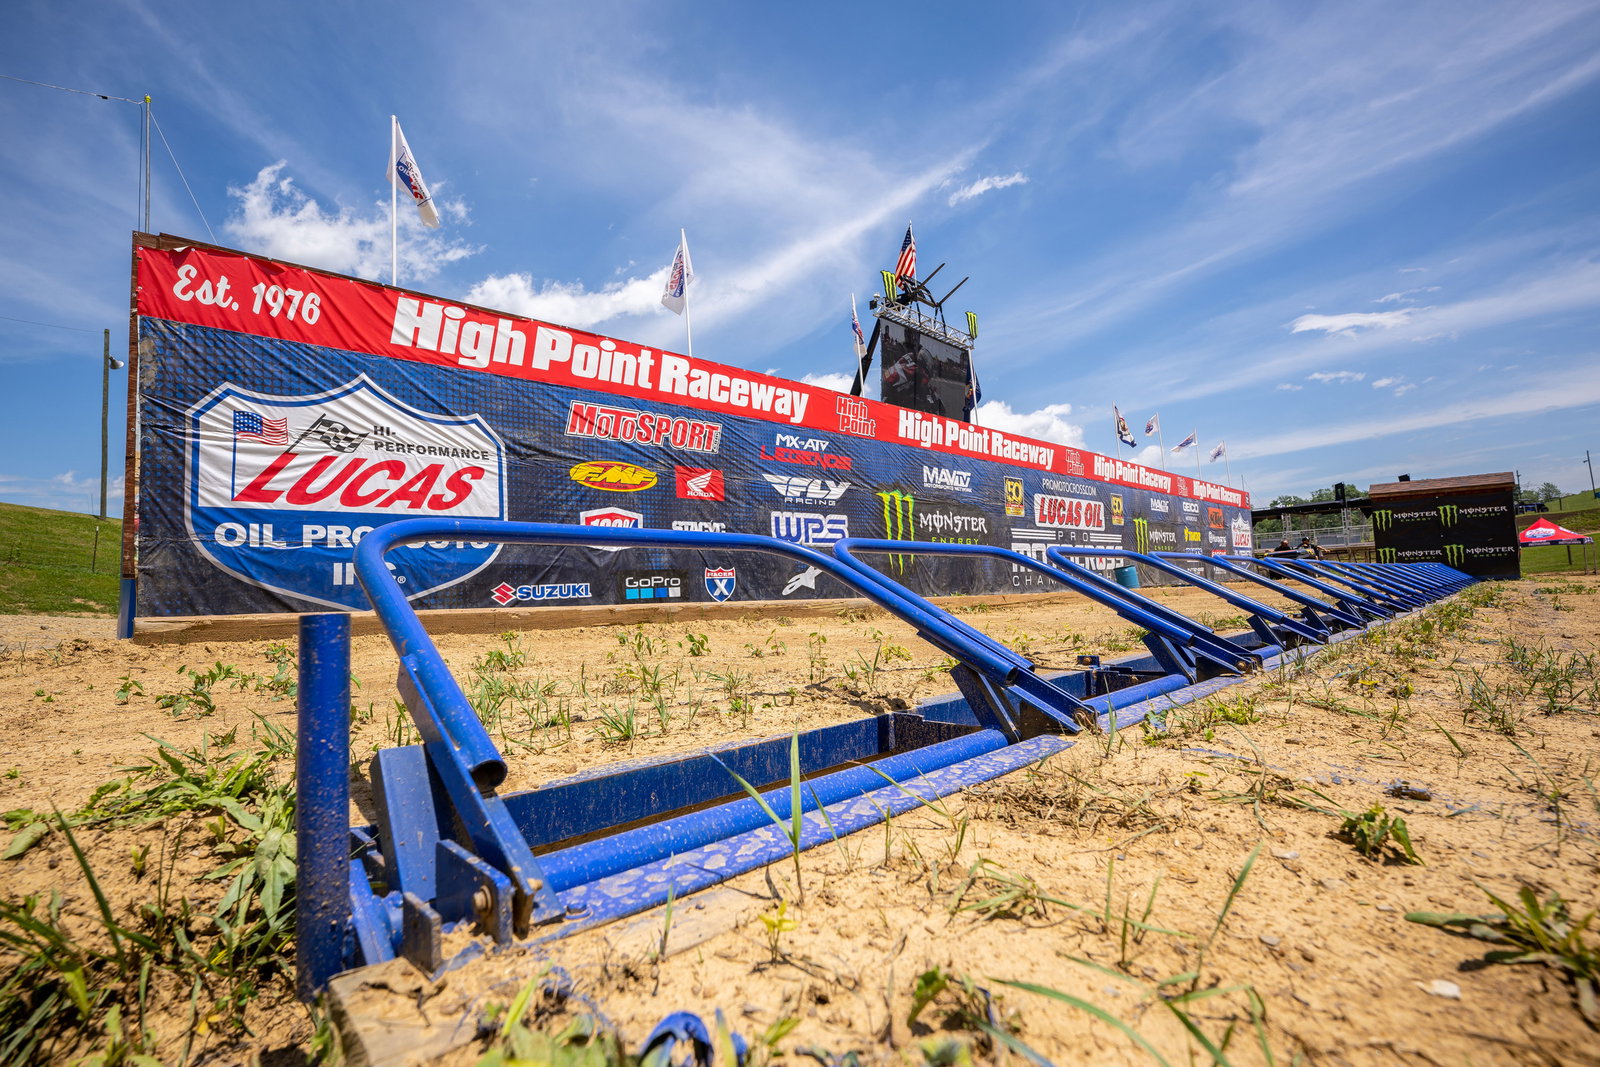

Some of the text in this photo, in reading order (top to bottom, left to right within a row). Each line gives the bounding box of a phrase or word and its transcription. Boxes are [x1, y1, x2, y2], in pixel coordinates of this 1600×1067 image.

[172, 264, 321, 325] Est. 1976
[390, 296, 809, 423] High Point Raceway
[836, 396, 868, 420] High
[373, 425, 396, 436] HI-
[840, 414, 876, 437] Point
[898, 410, 1054, 470] High Point Raceway
[374, 441, 489, 460] PERFORMANCE
[760, 445, 853, 471] LEGENDS
[231, 452, 485, 510] LUCAS
[571, 464, 657, 485] FMF
[1093, 455, 1116, 481] High
[1116, 462, 1139, 483] Point
[1139, 466, 1171, 494] Raceway
[687, 490, 715, 498] HONDA
[761, 474, 851, 500] FLY
[1193, 480, 1207, 500] High
[1206, 483, 1221, 500] Point
[1220, 486, 1242, 507] Raceway
[784, 497, 836, 506] RACING
[1182, 501, 1199, 513] GEICO
[1459, 505, 1508, 514] MONSTER
[919, 510, 988, 534] MONSTER
[1038, 497, 1082, 527] LUCAS
[1084, 502, 1103, 528] OIL
[1393, 510, 1438, 519] MONSTER
[214, 522, 286, 548] OIL
[772, 512, 847, 545] WPS
[1058, 531, 1089, 541] PRO
[1149, 529, 1176, 543] MONSTER
[931, 537, 979, 545] ENERGY
[1466, 546, 1515, 554] MONSTER
[1397, 549, 1442, 557] MONSTER
[516, 583, 592, 600] SUZUKI
[625, 576, 681, 588] GoPro
[713, 579, 729, 596] X
